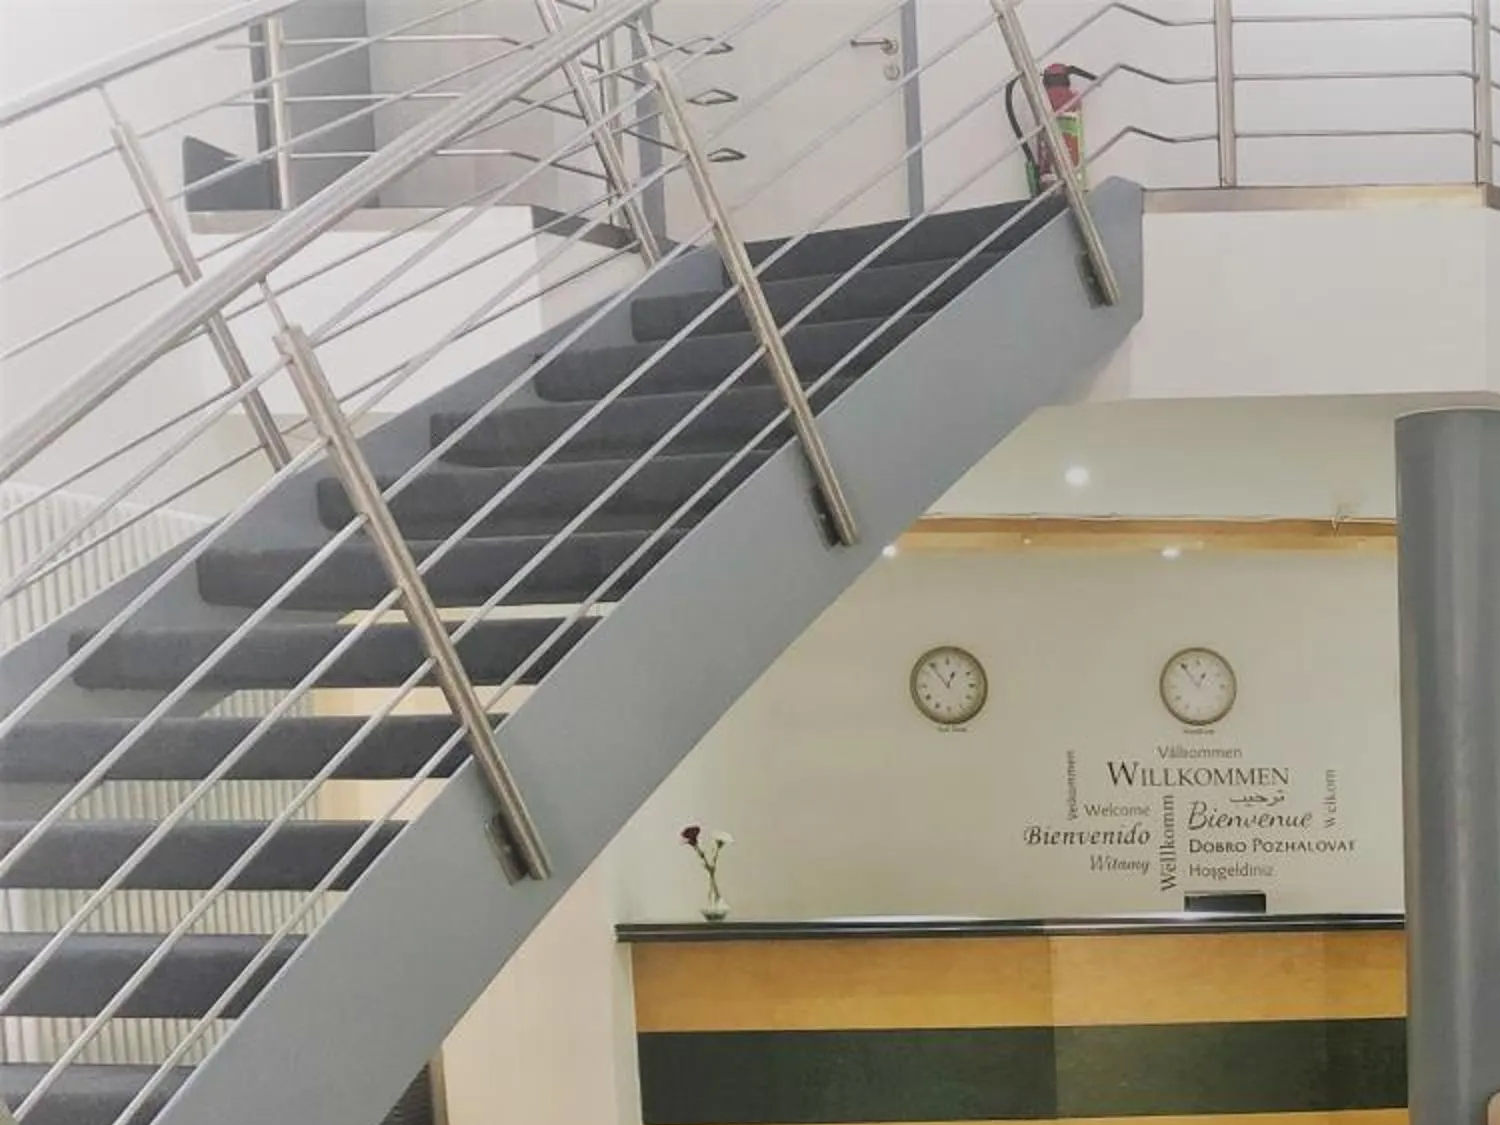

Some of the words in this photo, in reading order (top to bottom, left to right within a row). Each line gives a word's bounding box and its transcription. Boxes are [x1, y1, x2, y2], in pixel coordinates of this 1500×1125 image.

[1107, 761, 1289, 787] WILLKOMMEN
[1083, 802, 1151, 817] Welcome
[1323, 769, 1337, 829] Welkom
[1187, 800, 1313, 831] Bienvenue
[1024, 822, 1151, 845] Bienvenido
[1189, 838, 1247, 854] DOBRO
